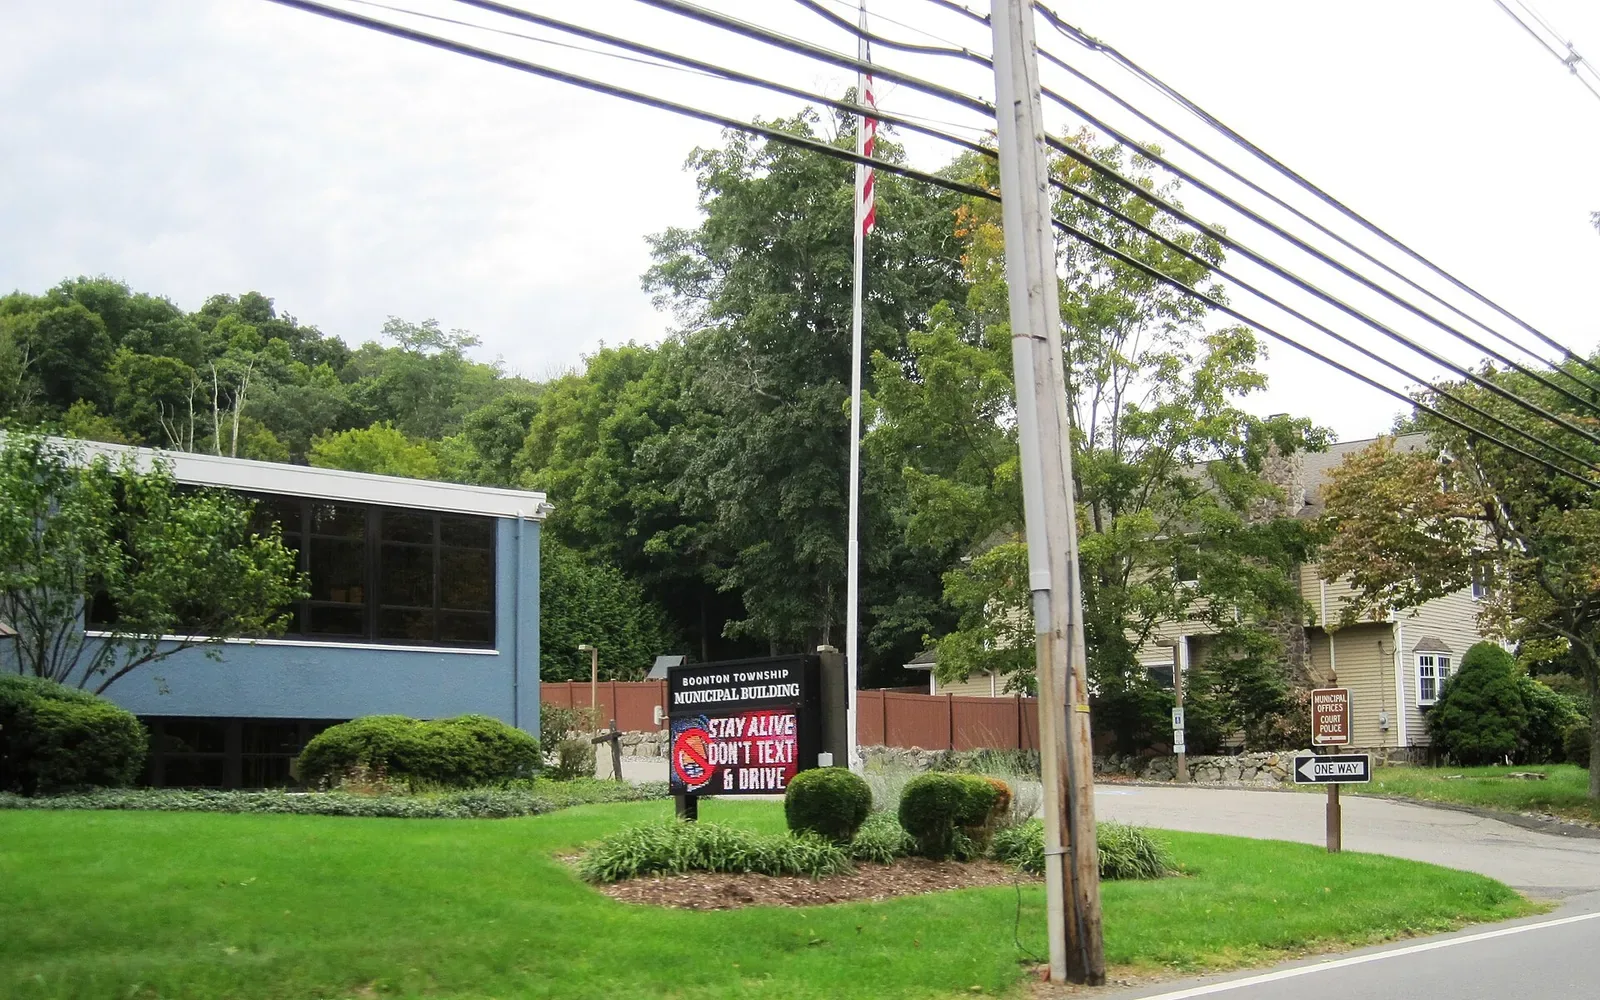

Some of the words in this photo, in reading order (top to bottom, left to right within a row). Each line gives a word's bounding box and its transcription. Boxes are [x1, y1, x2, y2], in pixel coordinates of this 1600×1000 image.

[682, 674, 730, 686] BOONTON
[734, 670, 789, 682] TOWNSHIP
[674, 689, 740, 704] MUNICIPAL
[741, 684, 800, 700] BUILDING
[1314, 694, 1346, 704] MUNICIPAL
[1317, 704, 1344, 712] OFFICES
[1320, 714, 1341, 724] COURT
[708, 717, 746, 738] STAY
[748, 714, 795, 736] ALIVE
[1320, 724, 1342, 732] POLICE
[708, 741, 752, 764] DON'T
[756, 740, 795, 764] TEXT
[1314, 764, 1334, 774] ONE
[1338, 764, 1358, 774] WAY
[724, 768, 734, 790] &
[740, 768, 786, 790] DRIVE
